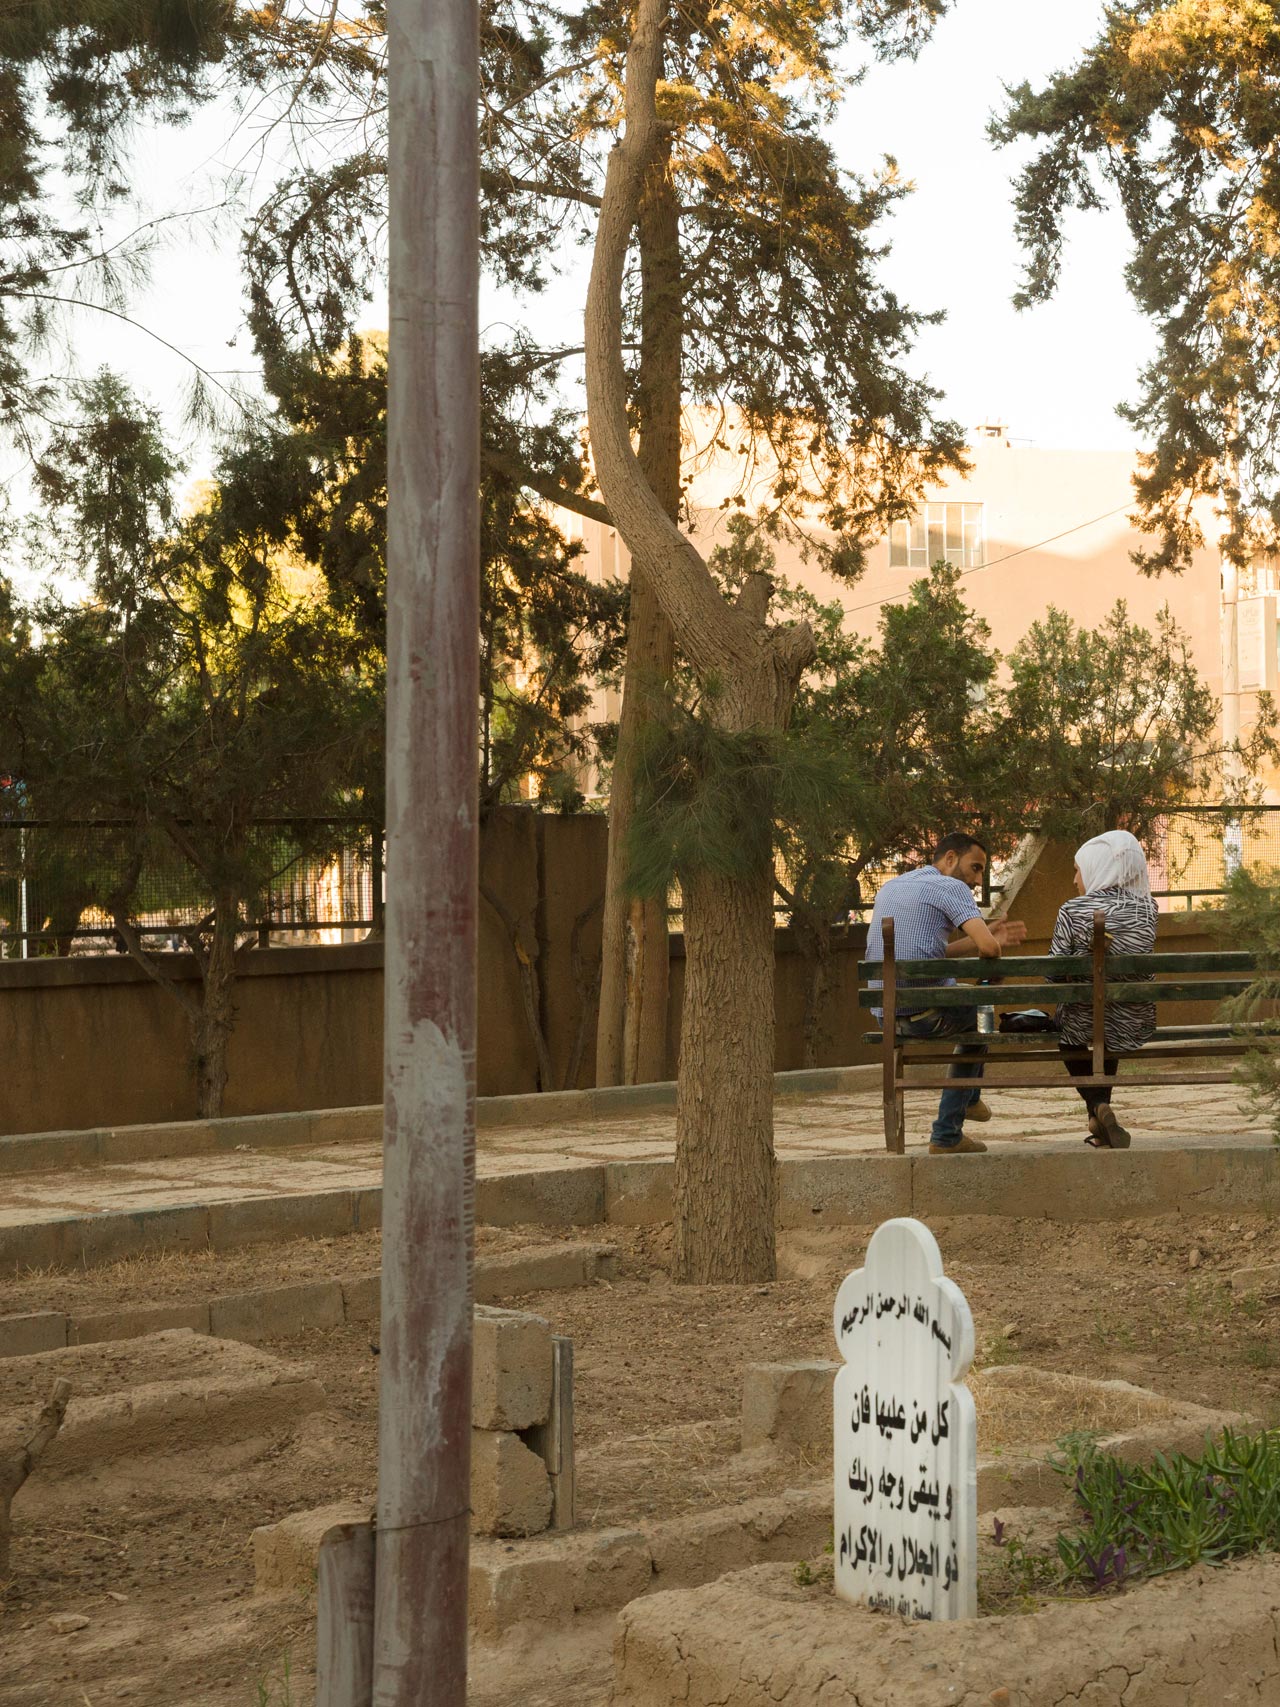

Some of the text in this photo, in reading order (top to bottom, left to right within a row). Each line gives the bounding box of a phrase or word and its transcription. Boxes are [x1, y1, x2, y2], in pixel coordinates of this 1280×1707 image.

[840, 1292, 951, 1359] بسم الله الرحمن الرحيم
[851, 1384, 949, 1446] كل من عليها فان
[848, 1456, 874, 1504] ربك
[878, 1466, 904, 1511] وجه
[897, 1533, 940, 1587] الجلال
[942, 1539, 959, 1591] ذو
[897, 1594, 910, 1616] الله
